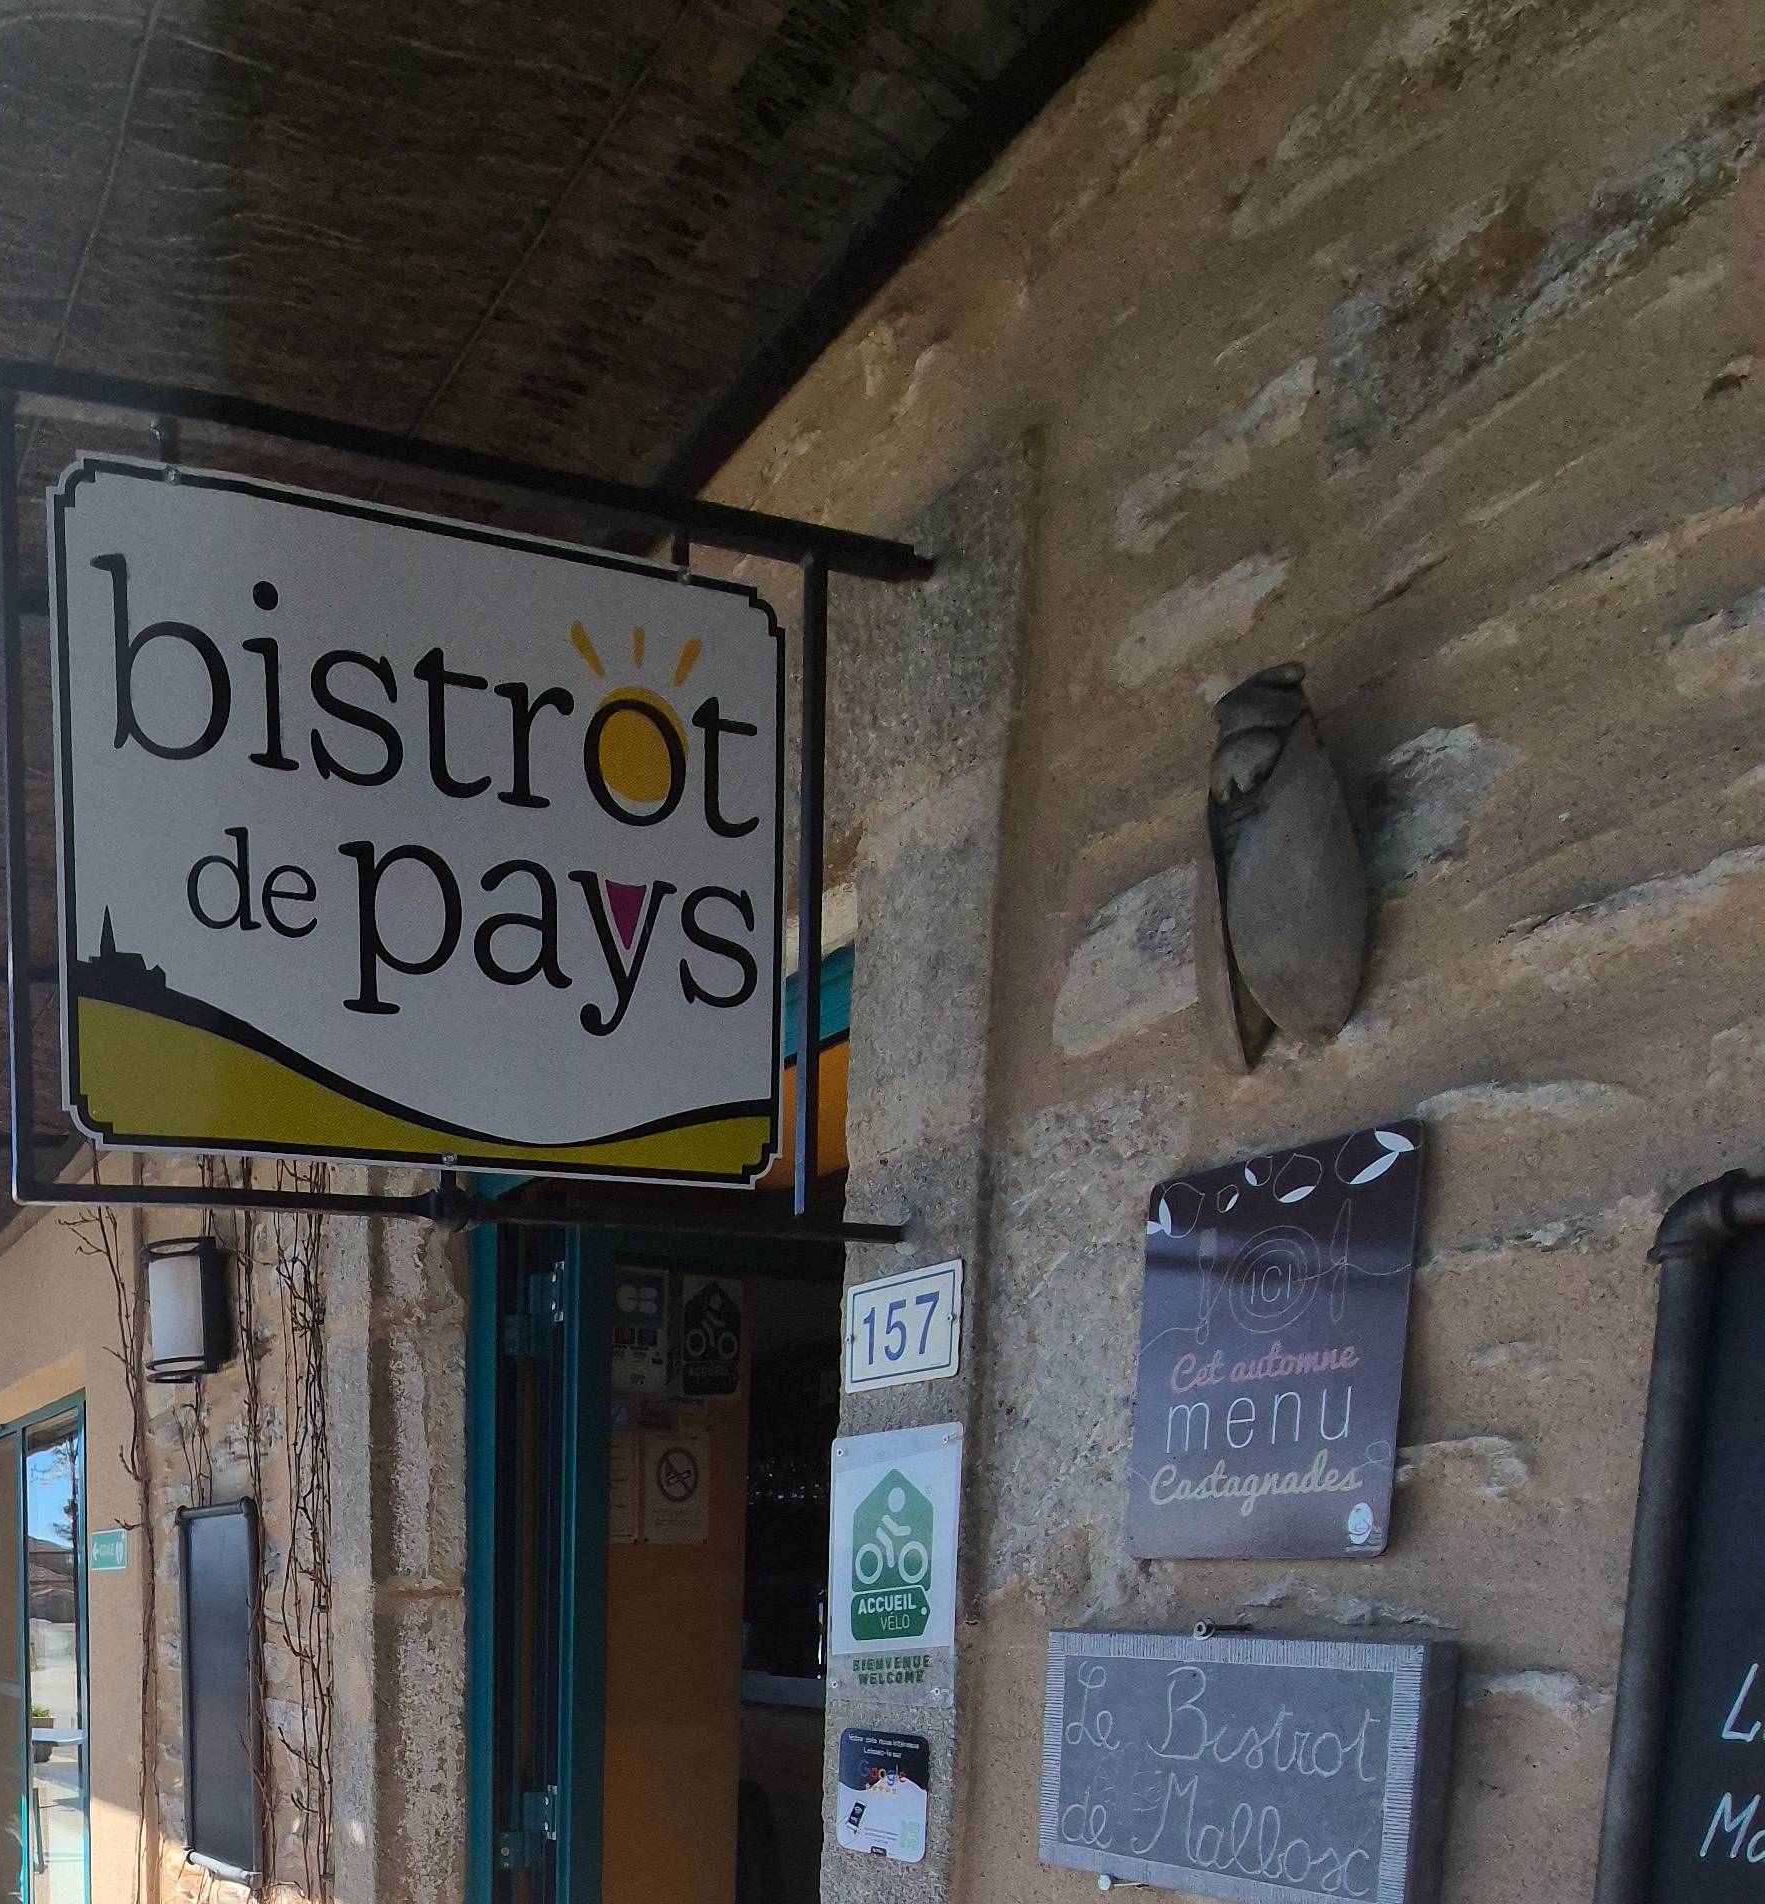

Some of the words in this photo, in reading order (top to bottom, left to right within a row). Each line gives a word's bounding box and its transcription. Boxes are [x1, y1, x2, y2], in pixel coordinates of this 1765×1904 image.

[90, 553, 760, 838] bistrot
[186, 827, 318, 939] de
[338, 840, 758, 1037] pays
[1250, 1263, 1293, 1305] ICI
[863, 1290, 940, 1366] 157
[1170, 1349, 1225, 1394] Cet
[1229, 1339, 1360, 1383] automne
[1166, 1385, 1353, 1454] menu
[1149, 1448, 1364, 1517] Castagnades
[857, 1593, 917, 1616] ACCUEIL
[880, 1611, 911, 1632] VÉLO
[852, 1654, 932, 1672] BIENVENUE
[858, 1669, 925, 1686] WELCOME
[1064, 1660, 1121, 1751] Le
[1147, 1665, 1381, 1783] Bistrot
[858, 1760, 907, 1787] Google
[1061, 1784, 1113, 1850] de
